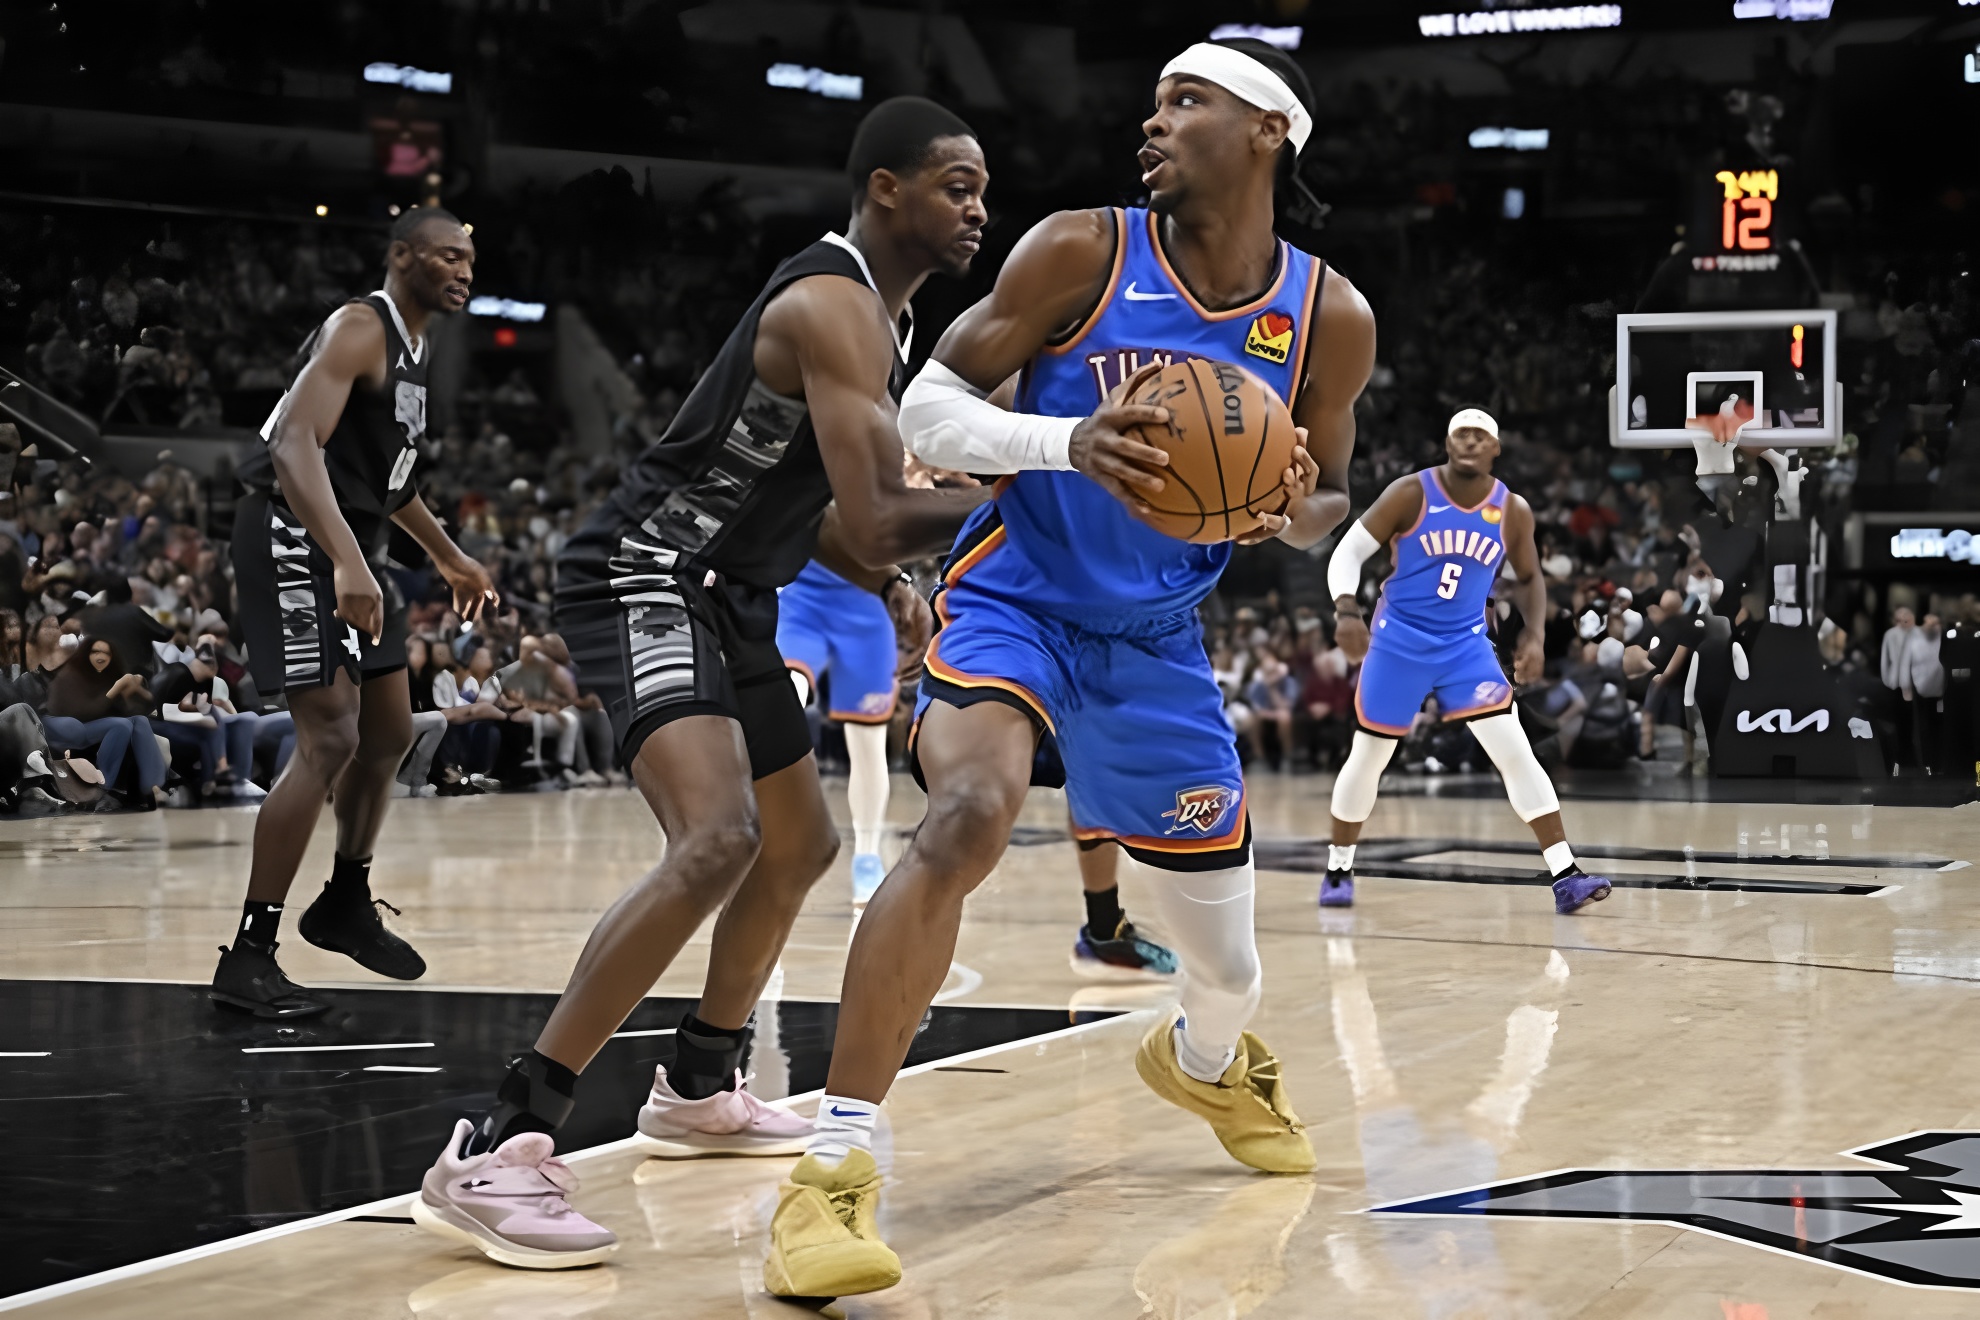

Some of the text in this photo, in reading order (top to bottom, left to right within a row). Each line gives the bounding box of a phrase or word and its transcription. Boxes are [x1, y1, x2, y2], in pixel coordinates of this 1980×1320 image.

[1418, 14, 1454, 36] WE
[1457, 11, 1510, 35] LOVE
[1723, 197, 1771, 249] 12
[1437, 562, 1463, 600] 5
[1736, 708, 1830, 734] KIA
